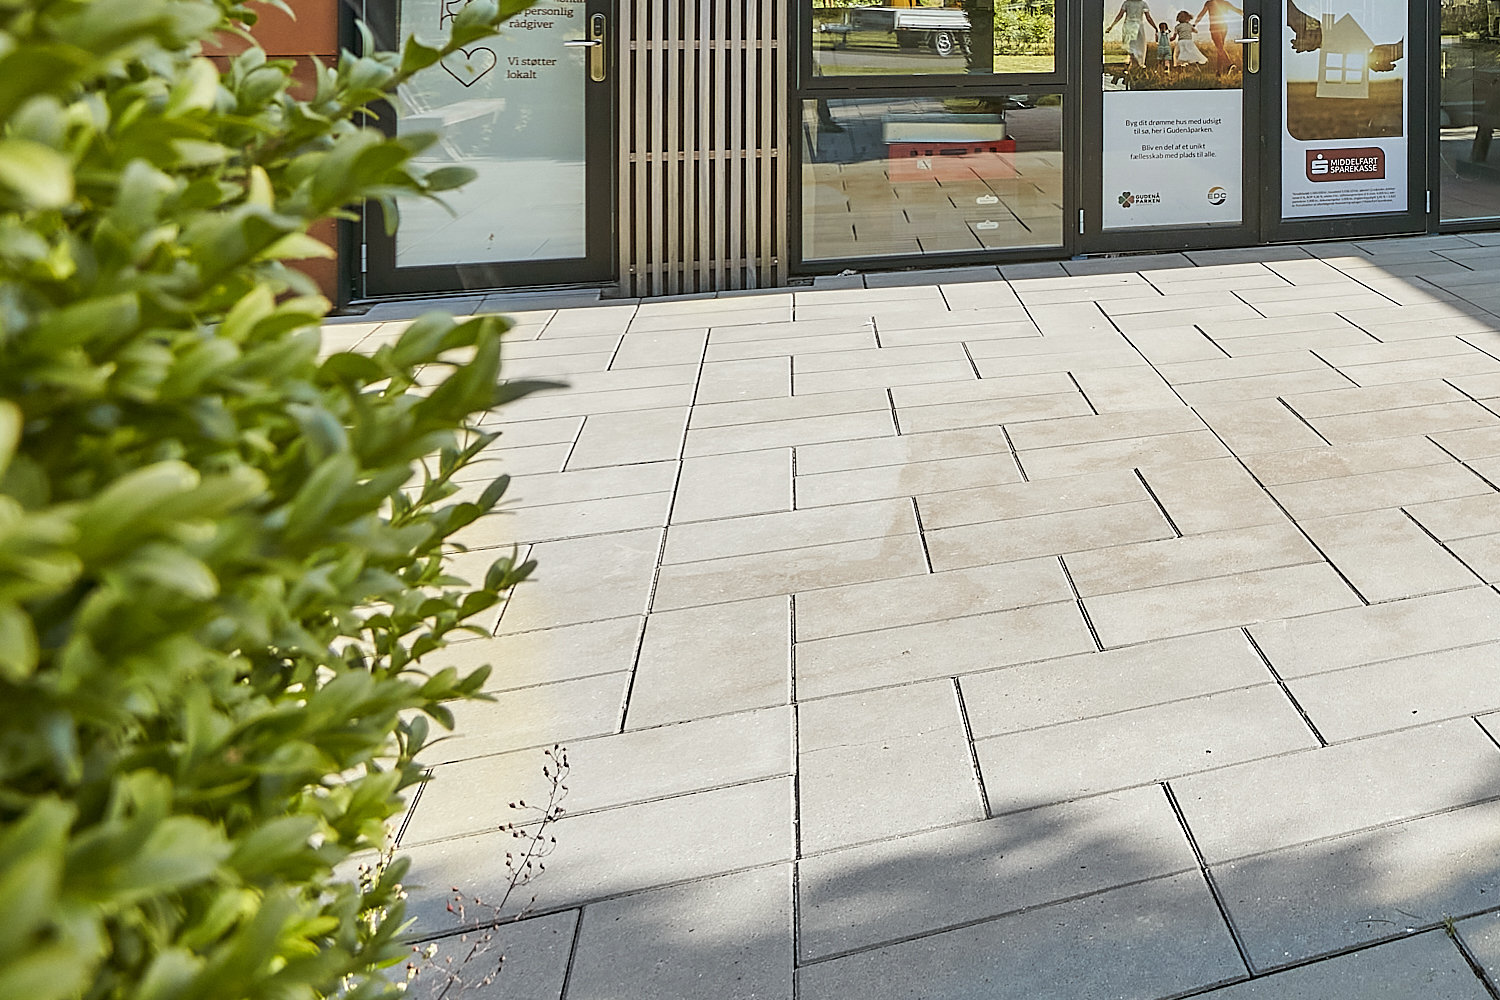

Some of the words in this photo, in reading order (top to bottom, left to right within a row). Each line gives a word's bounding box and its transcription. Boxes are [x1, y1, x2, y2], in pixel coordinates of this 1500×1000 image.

[524, 7, 574, 18] personlig
[509, 20, 554, 30] rådgiver
[508, 57, 519, 66] Vi
[521, 57, 557, 67] støtter
[507, 69, 537, 79] lokalt
[1125, 119, 1138, 127] Byg
[1202, 117, 1222, 126] udsigt
[1189, 142, 1206, 150] unikt
[1130, 152, 1164, 160] fællesskab
[1179, 151, 1196, 159] plads
[1330, 157, 1378, 167] MIDDELFART
[1330, 165, 1378, 174] SPAREKASSE
[1135, 192, 1160, 200] GUDENÅ
[1207, 192, 1227, 200] EDC
